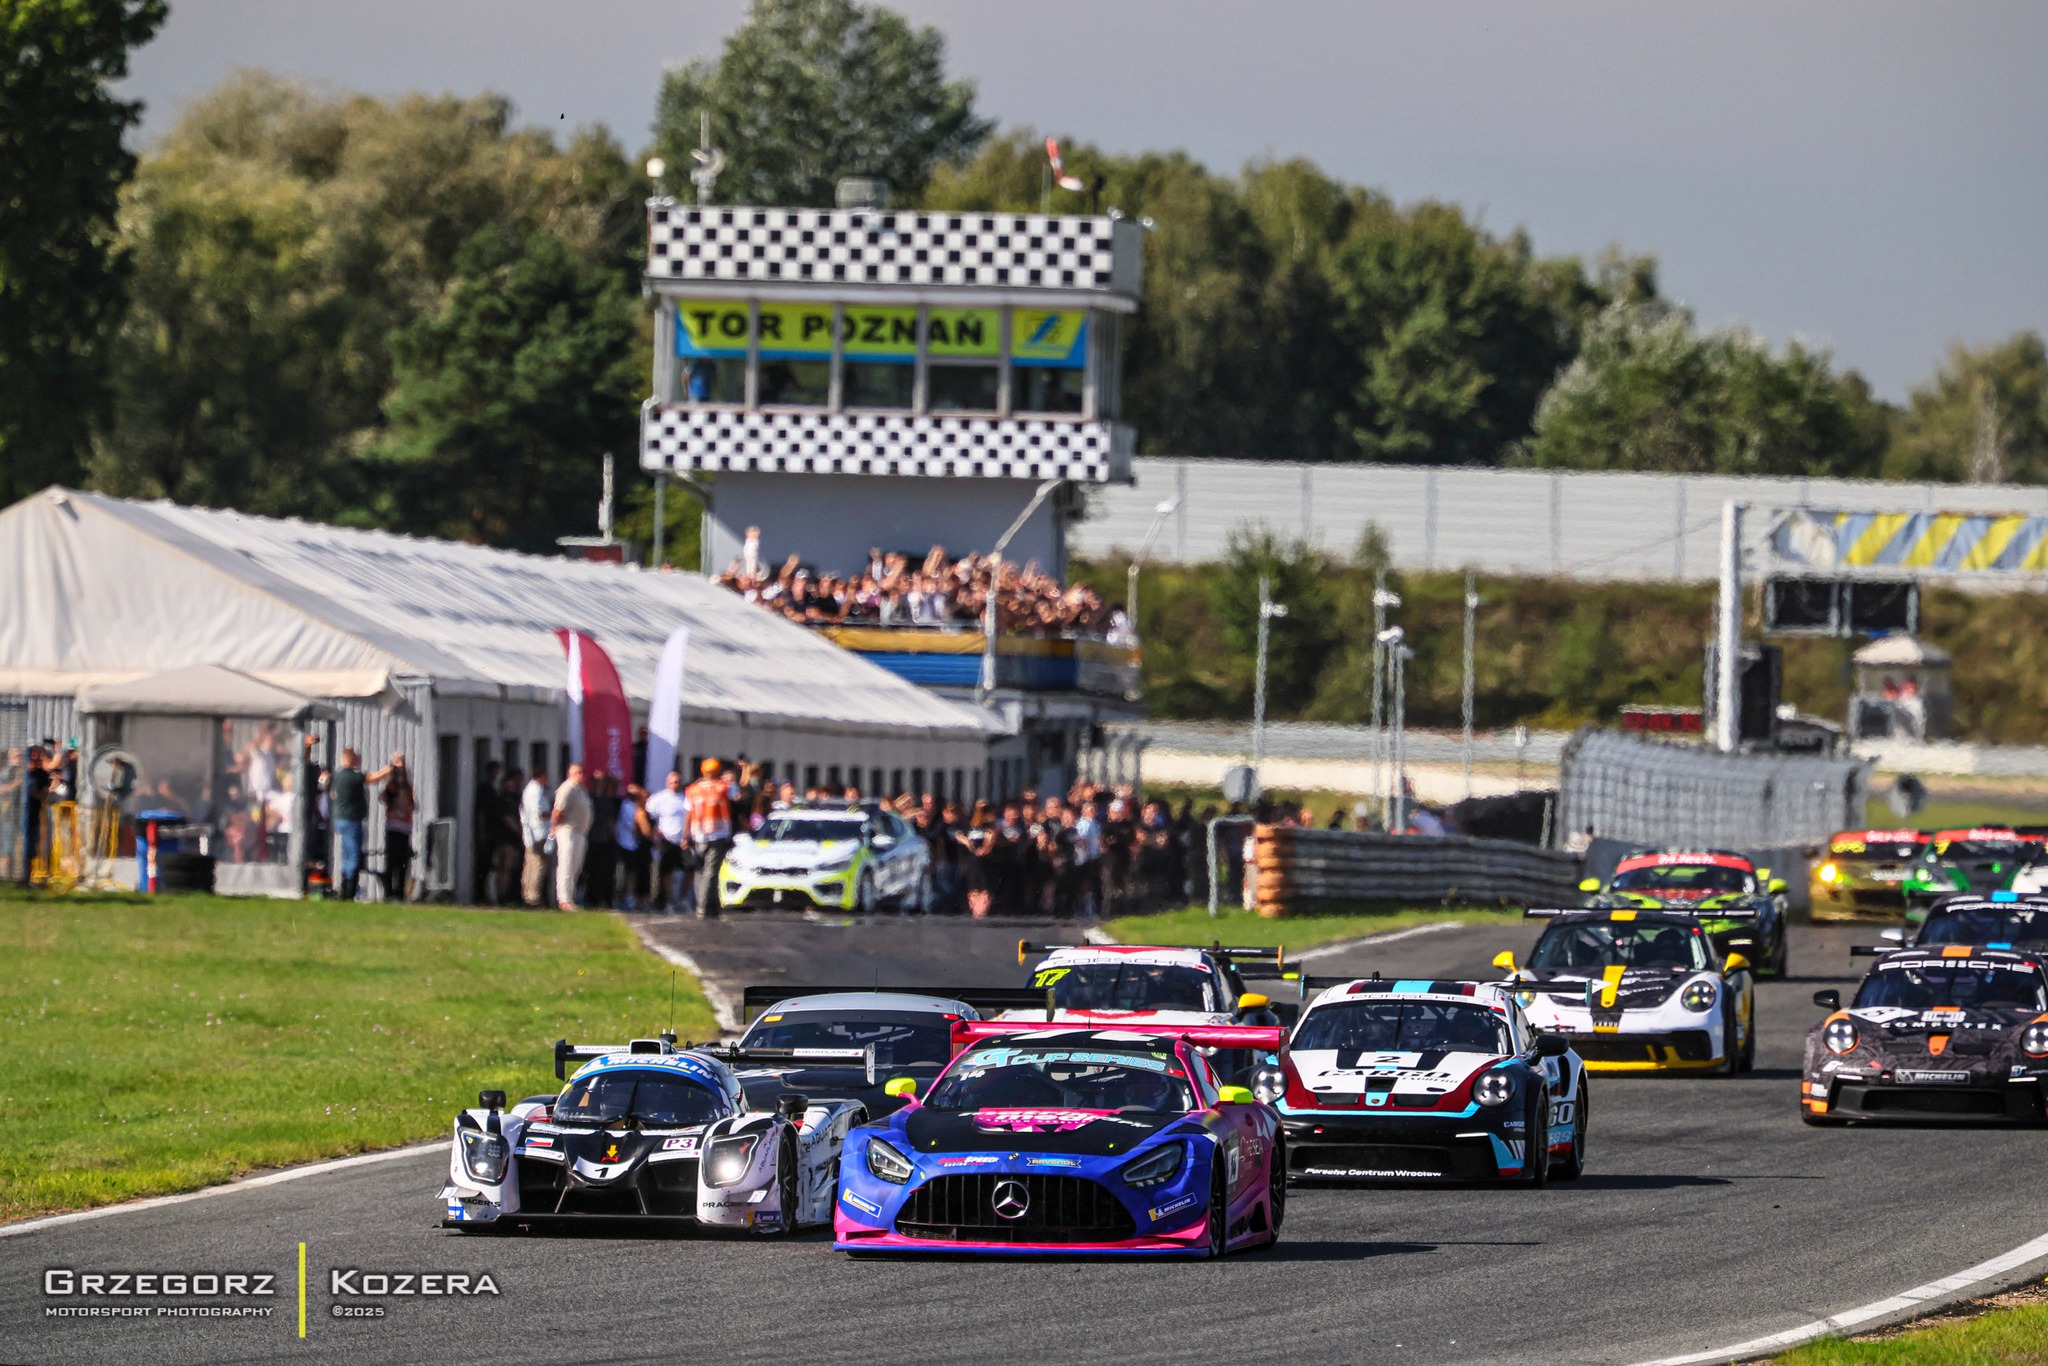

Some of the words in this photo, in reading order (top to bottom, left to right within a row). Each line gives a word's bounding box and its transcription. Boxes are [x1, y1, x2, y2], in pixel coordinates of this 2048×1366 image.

[692, 311, 782, 341] TOR
[801, 308, 985, 346] POZNAŃ
[1878, 960, 2035, 974] PORSCHE
[1034, 967, 1072, 988] 17
[1880, 1022, 2003, 1031] COMPUTEX
[1374, 1055, 1402, 1064] 2
[607, 1057, 713, 1079] MICHELIN
[1914, 1072, 1967, 1081] MICHELIN
[666, 1138, 693, 1149] P3
[594, 1166, 610, 1179] 1
[1304, 1167, 1346, 1176] Porsche
[1348, 1169, 1394, 1177] Centrum
